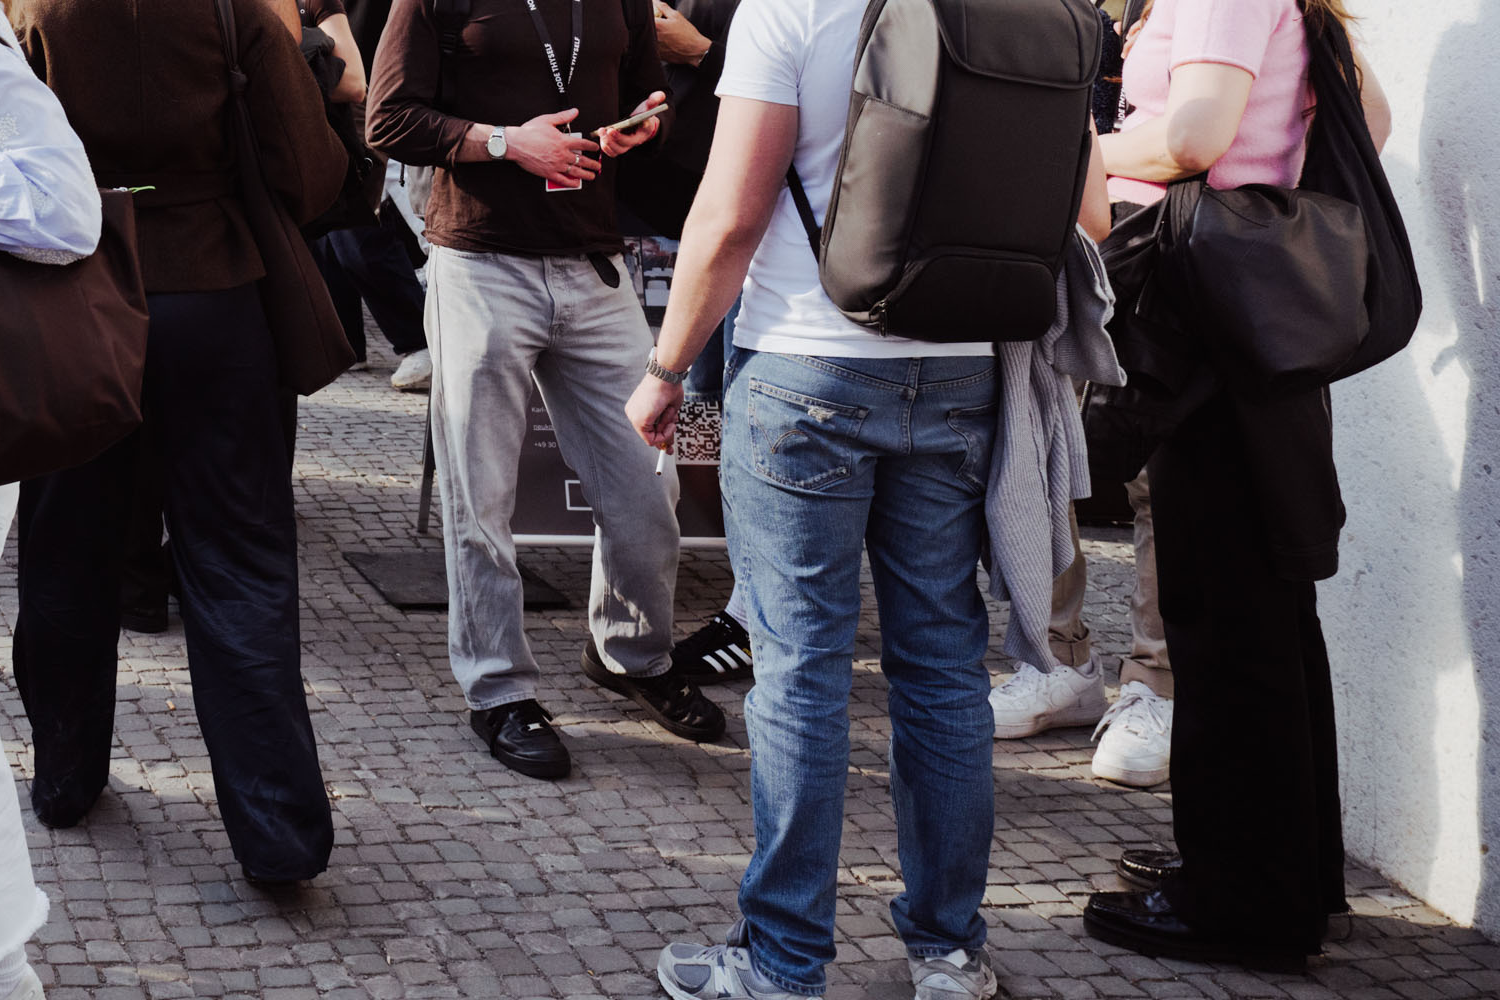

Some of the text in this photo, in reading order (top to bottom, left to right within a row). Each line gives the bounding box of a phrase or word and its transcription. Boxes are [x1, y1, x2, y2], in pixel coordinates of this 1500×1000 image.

[544, 43, 565, 94] NODE THYSELF
[571, 36, 581, 66] THYSELF
